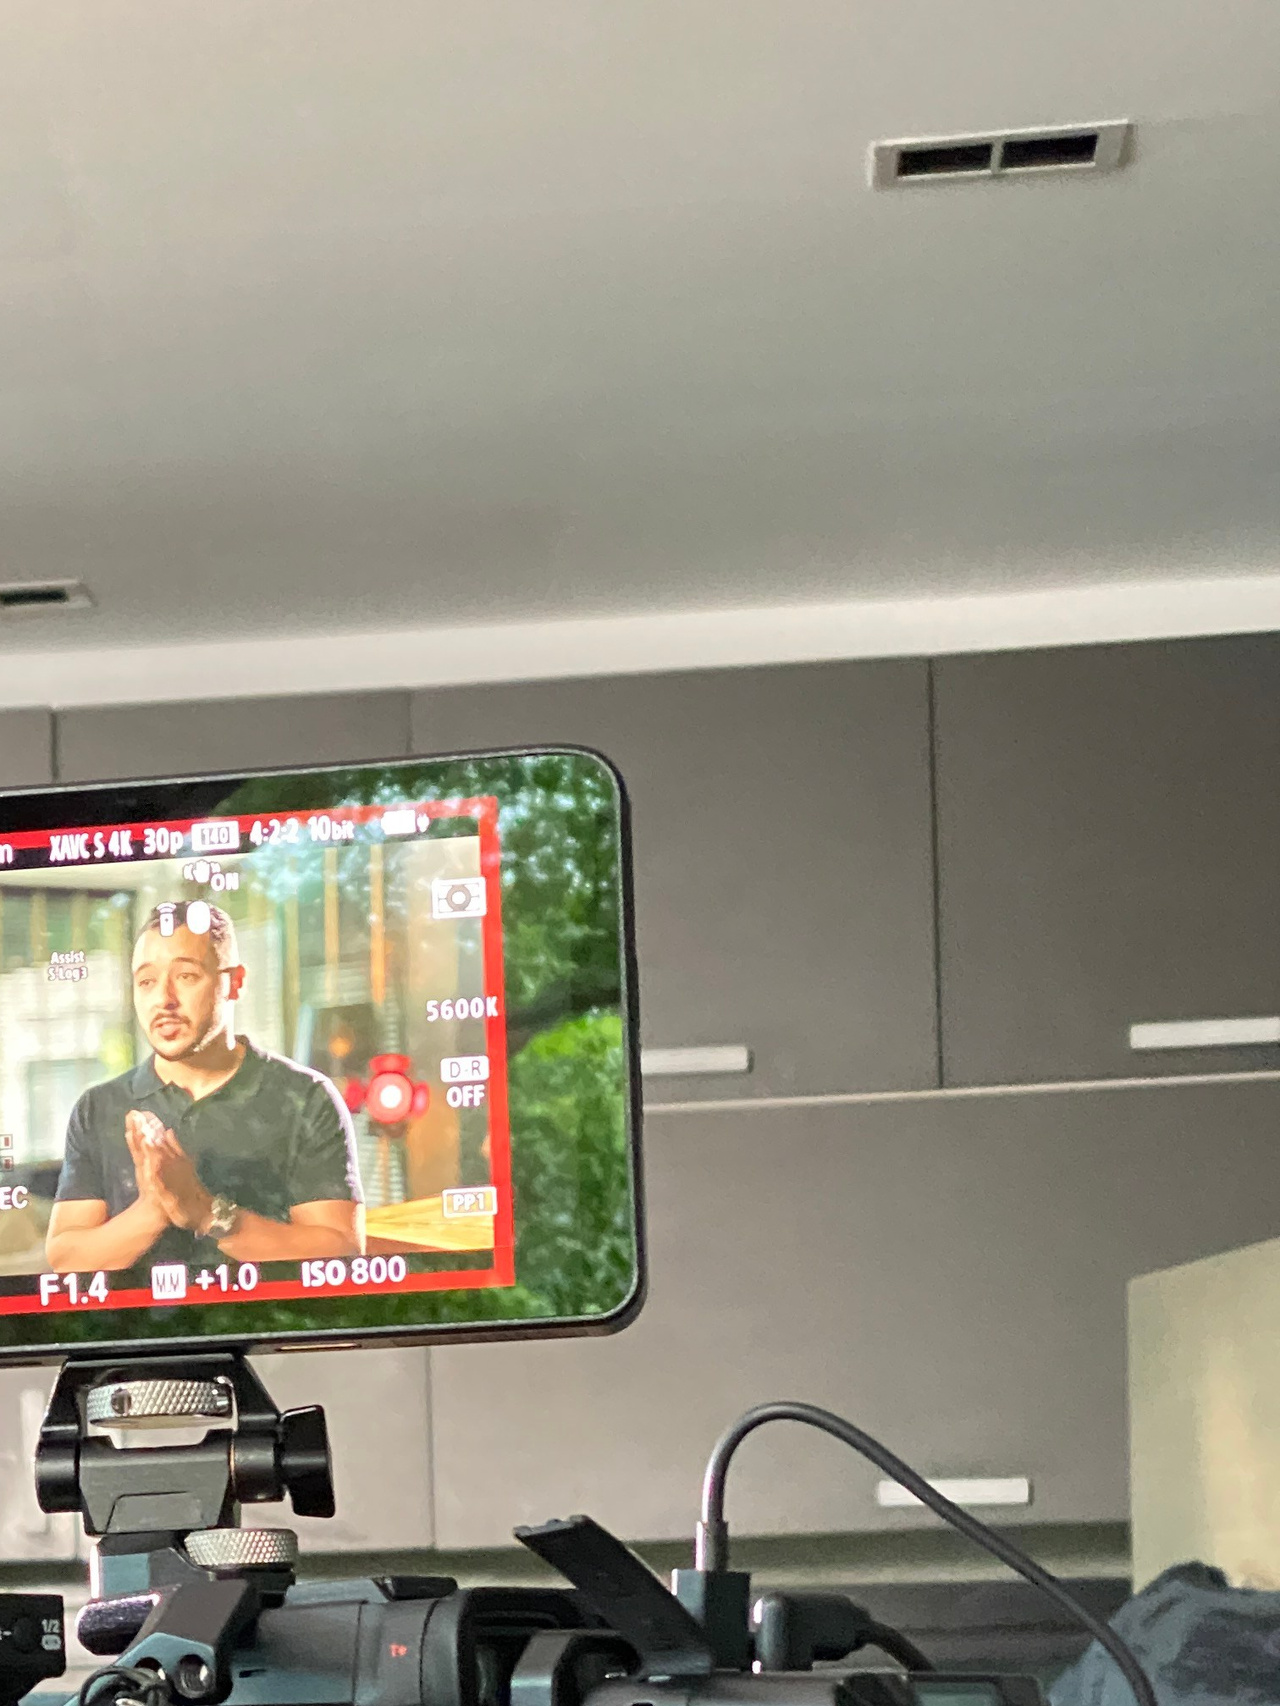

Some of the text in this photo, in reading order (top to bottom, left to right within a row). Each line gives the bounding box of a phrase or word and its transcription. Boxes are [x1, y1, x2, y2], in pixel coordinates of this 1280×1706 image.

[49, 830, 134, 862] XAVC S 4K
[143, 827, 184, 855] 30p
[249, 817, 300, 847] 4:2:2
[210, 871, 239, 892] ON
[426, 996, 499, 1022] 5600K
[446, 1084, 485, 1108] OFF
[452, 1192, 486, 1211] PP1
[195, 1262, 258, 1291] +1.0
[301, 1256, 406, 1287] ISO 800
[39, 1270, 109, 1306] F1.4
